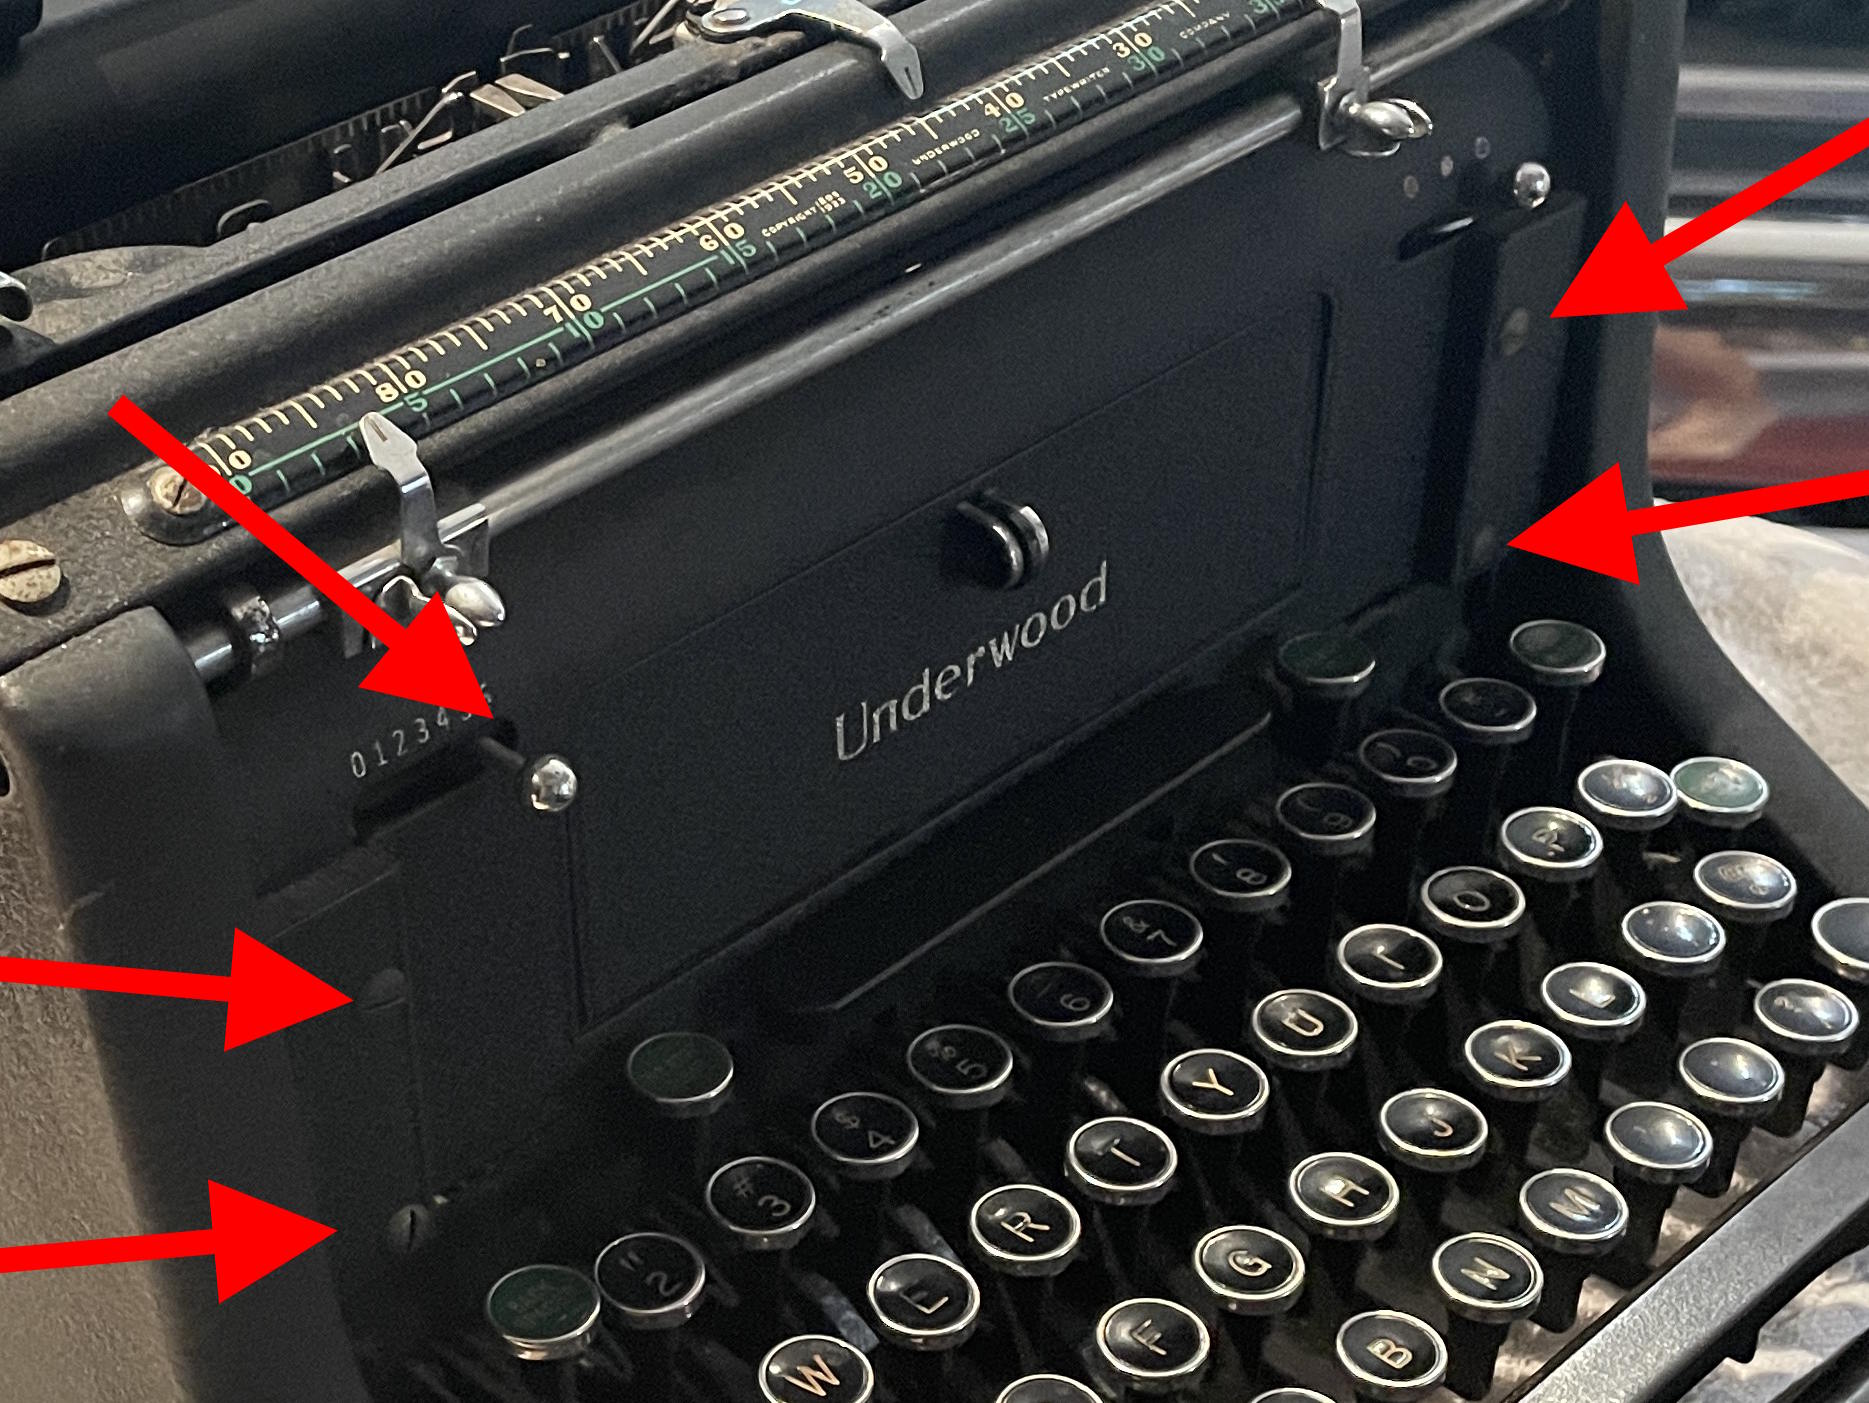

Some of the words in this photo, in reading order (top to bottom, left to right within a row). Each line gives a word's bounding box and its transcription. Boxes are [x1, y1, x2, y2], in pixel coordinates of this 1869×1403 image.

[1112, 32, 1153, 58] 30
[1128, 46, 1165, 71] 30
[911, 128, 981, 165] UNDERWOOD
[1179, 11, 1230, 39] COMPANY
[984, 92, 1025, 118] 40
[999, 107, 1036, 133] 25
[842, 155, 888, 184] 50
[862, 171, 902, 199] 20
[761, 206, 818, 237] COPYRIGHT
[699, 222, 745, 251] 60
[720, 239, 756, 265] 15
[543, 293, 592, 324] 70
[564, 311, 604, 338] 10
[375, 369, 427, 403] 80
[404, 396, 428, 412] 5
[835, 560, 1107, 761] Underwood
[1236, 868, 1268, 885] 8
[1147, 929, 1177, 947] 7
[1060, 993, 1091, 1011] 6
[1283, 1008, 1324, 1037] U
[955, 1058, 988, 1079] 5
[1494, 1044, 1542, 1071] K
[1192, 1068, 1234, 1096] Y
[867, 1129, 896, 1149] 4
[757, 1194, 791, 1217] 3
[1320, 1176, 1370, 1208] H
[1549, 1186, 1601, 1220] M
[1001, 1211, 1050, 1243] R
[1226, 1250, 1272, 1277] G
[1460, 1257, 1511, 1290] N
[645, 1271, 682, 1297] 2
[1130, 1319, 1167, 1355] F
[1366, 1338, 1412, 1369] B
[784, 1352, 840, 1397] W
